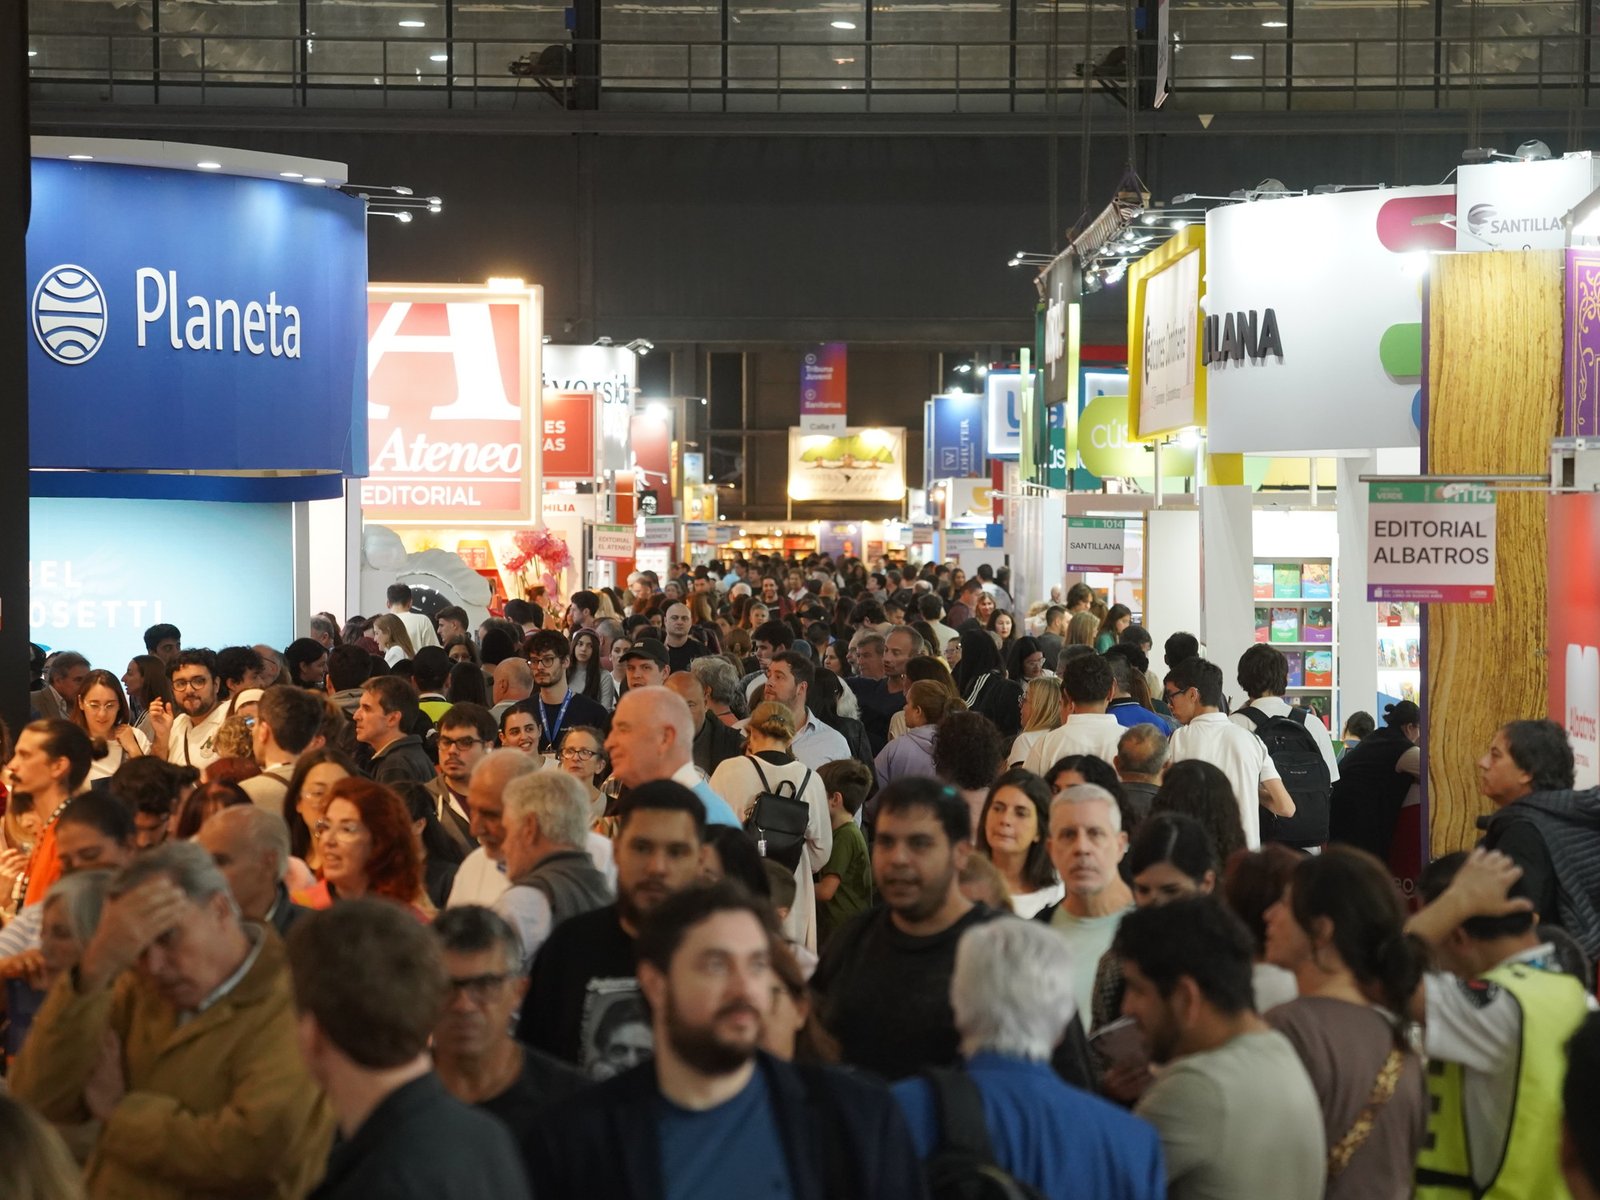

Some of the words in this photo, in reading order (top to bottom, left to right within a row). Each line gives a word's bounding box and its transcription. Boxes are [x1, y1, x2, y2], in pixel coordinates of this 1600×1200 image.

[136, 267, 301, 358] Planeta
[369, 427, 521, 474] Ateneo
[361, 486, 480, 507] EDITORIAL
[1102, 519, 1123, 528] 1014
[1374, 521, 1487, 538] EDITORIAL
[598, 536, 630, 544] EDITORIAL
[1070, 542, 1121, 550] SANTILLANA
[1373, 547, 1489, 565] ALBATROS
